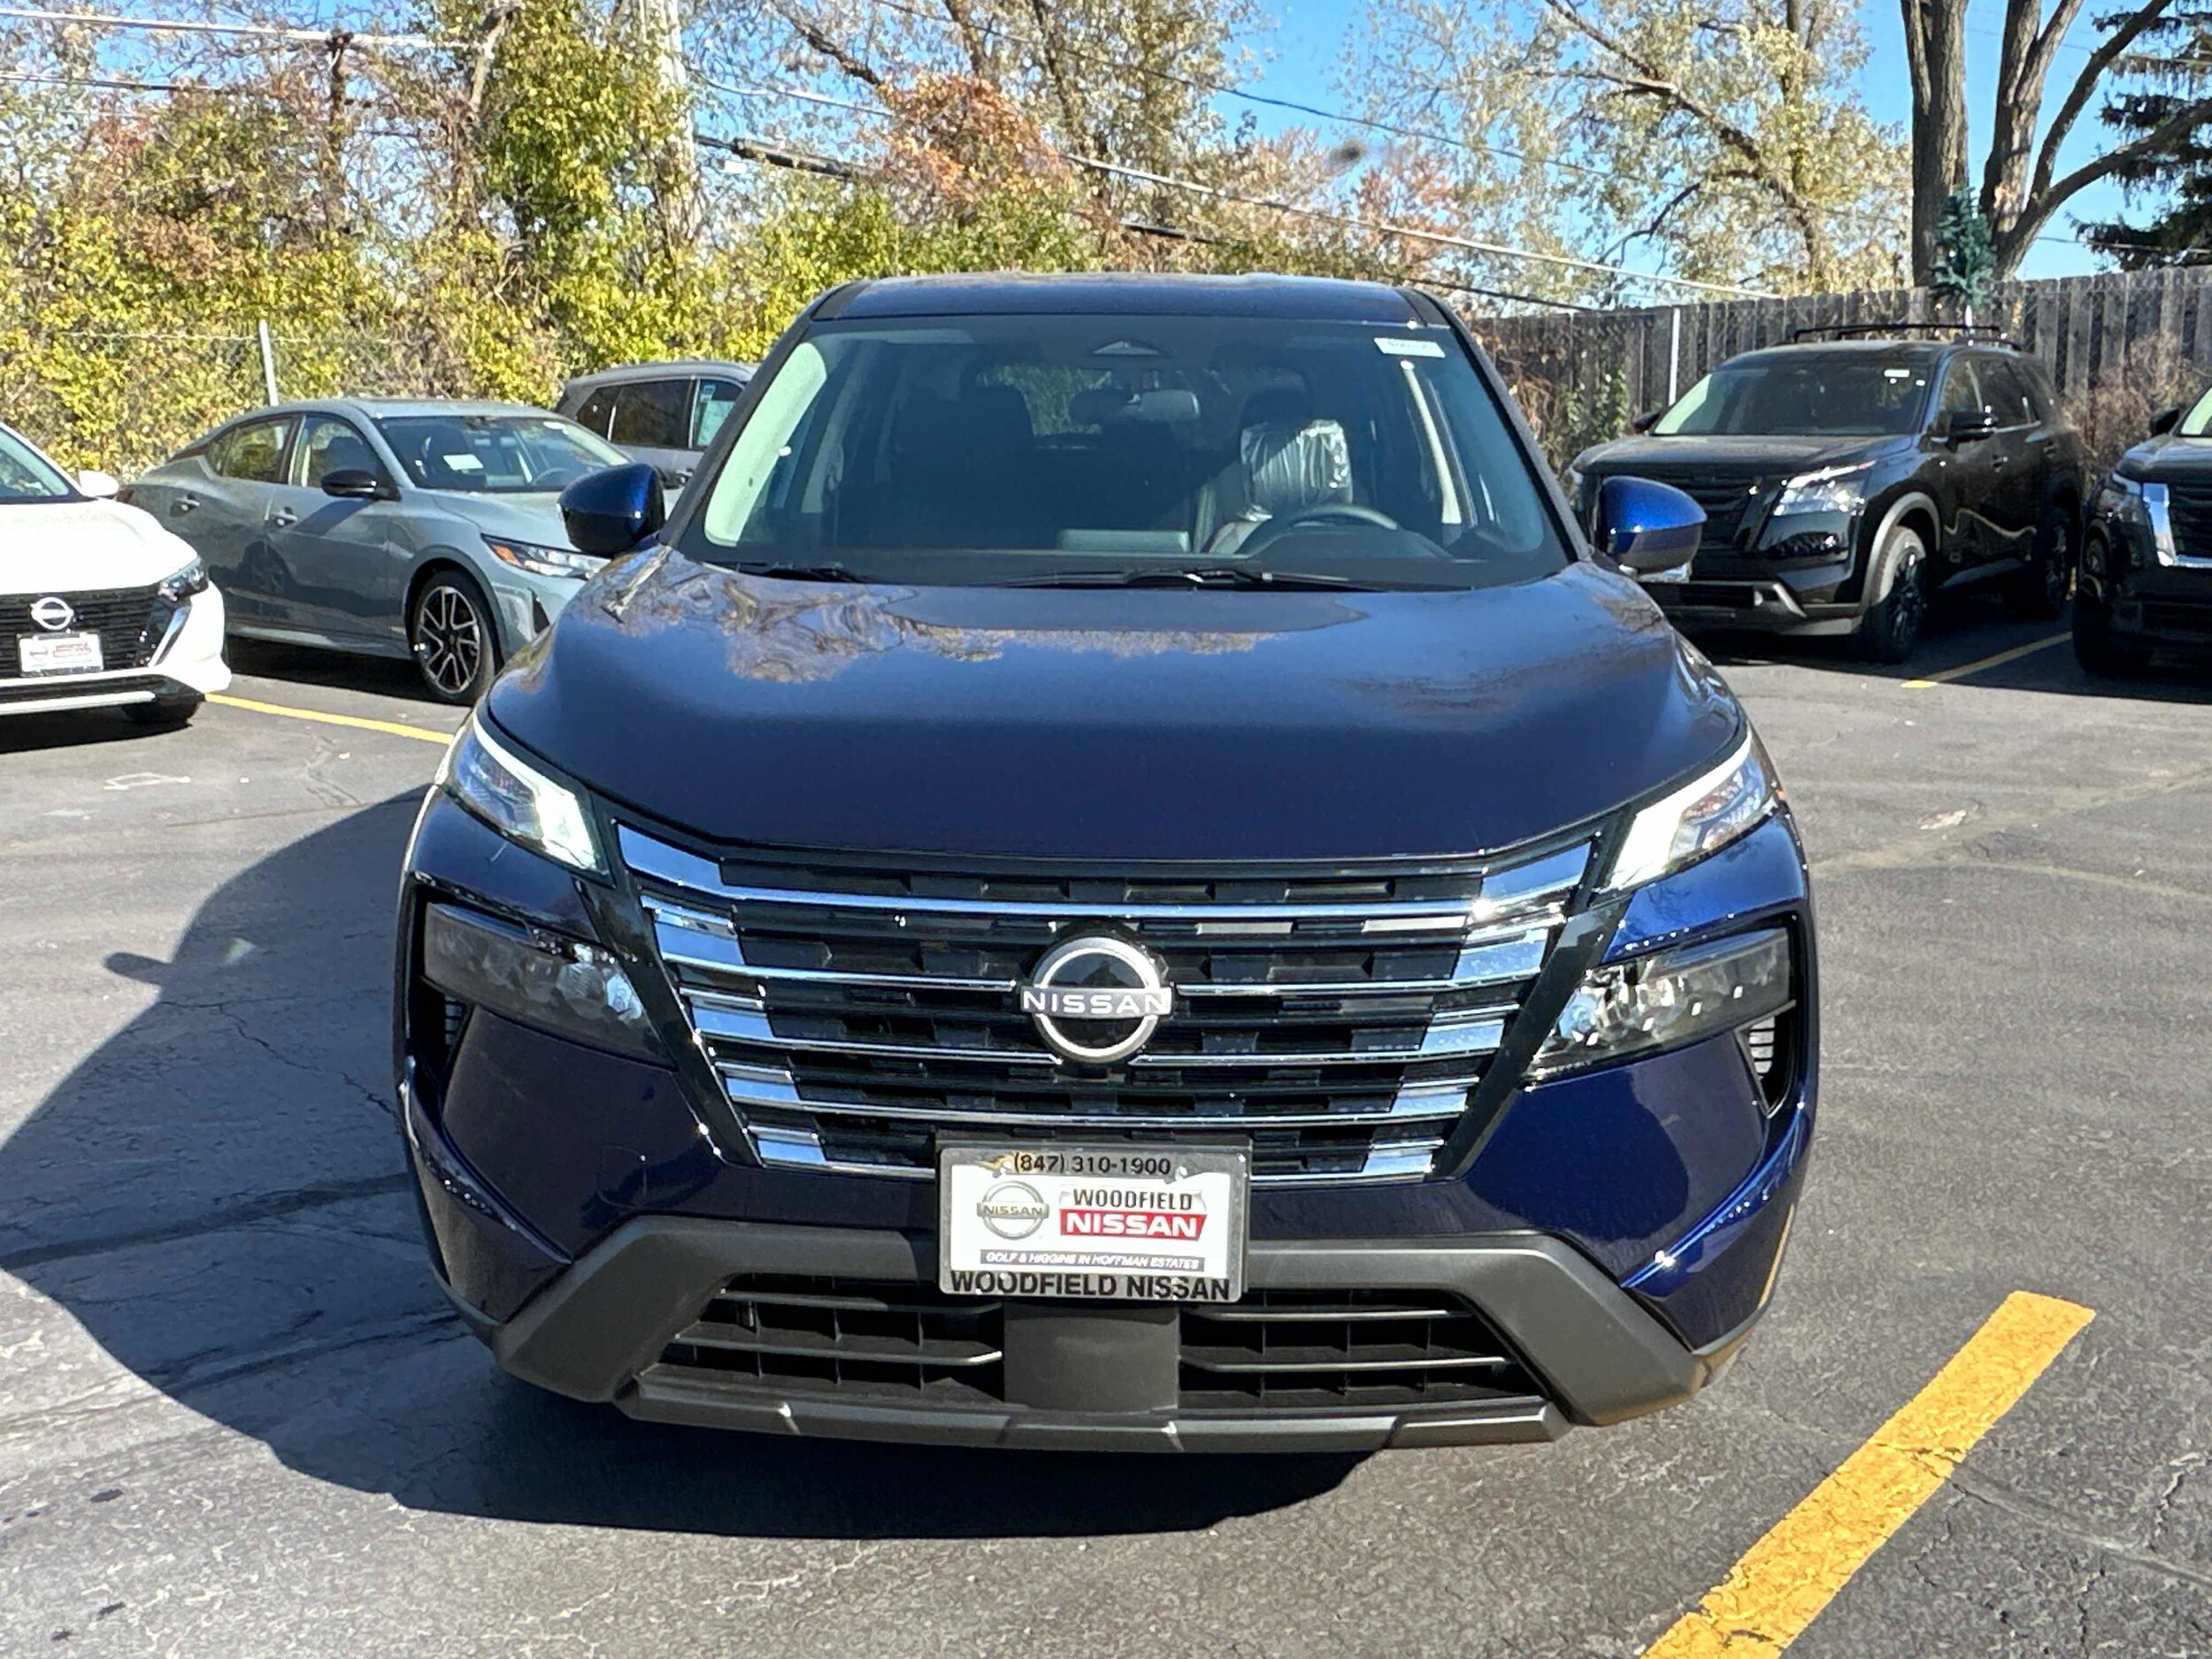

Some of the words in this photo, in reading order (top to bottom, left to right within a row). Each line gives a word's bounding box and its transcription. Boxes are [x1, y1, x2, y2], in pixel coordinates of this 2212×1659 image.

[1023, 990, 1167, 1014] NISSAN
[1014, 1152, 1065, 1176] (847)
[1072, 1155, 1171, 1176] 310-1900
[982, 1204, 1044, 1217] NISSAN
[1073, 1187, 1194, 1211] WOODFIELD
[1065, 1212, 1198, 1238] NISSAN
[986, 1251, 1018, 1263] GOLF
[1078, 1254, 1091, 1264] IN
[1092, 1255, 1149, 1267] HOFFMAN
[1150, 1256, 1200, 1270] ESTATES
[950, 1270, 1117, 1296] WOODFIELD
[1126, 1275, 1230, 1302] NISSAN
